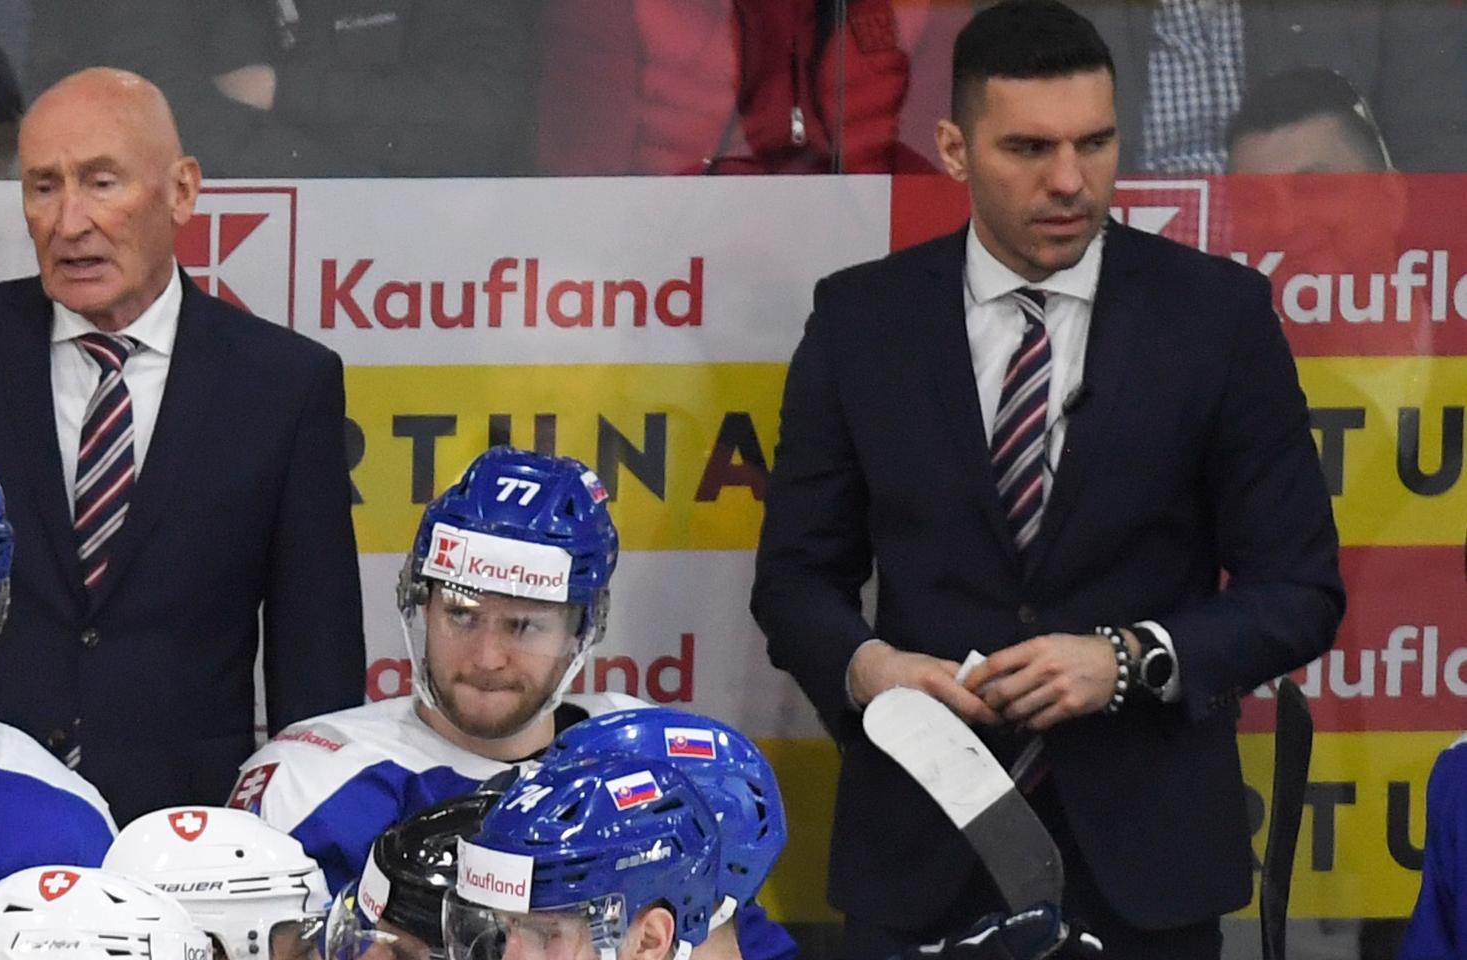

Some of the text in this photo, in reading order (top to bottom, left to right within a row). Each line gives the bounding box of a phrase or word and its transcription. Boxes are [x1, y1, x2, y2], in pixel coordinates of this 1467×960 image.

[320, 256, 704, 330] Kaufland
[495, 476, 542, 507] 77
[467, 555, 564, 589] Kaufland
[464, 865, 527, 898] Kaufland
